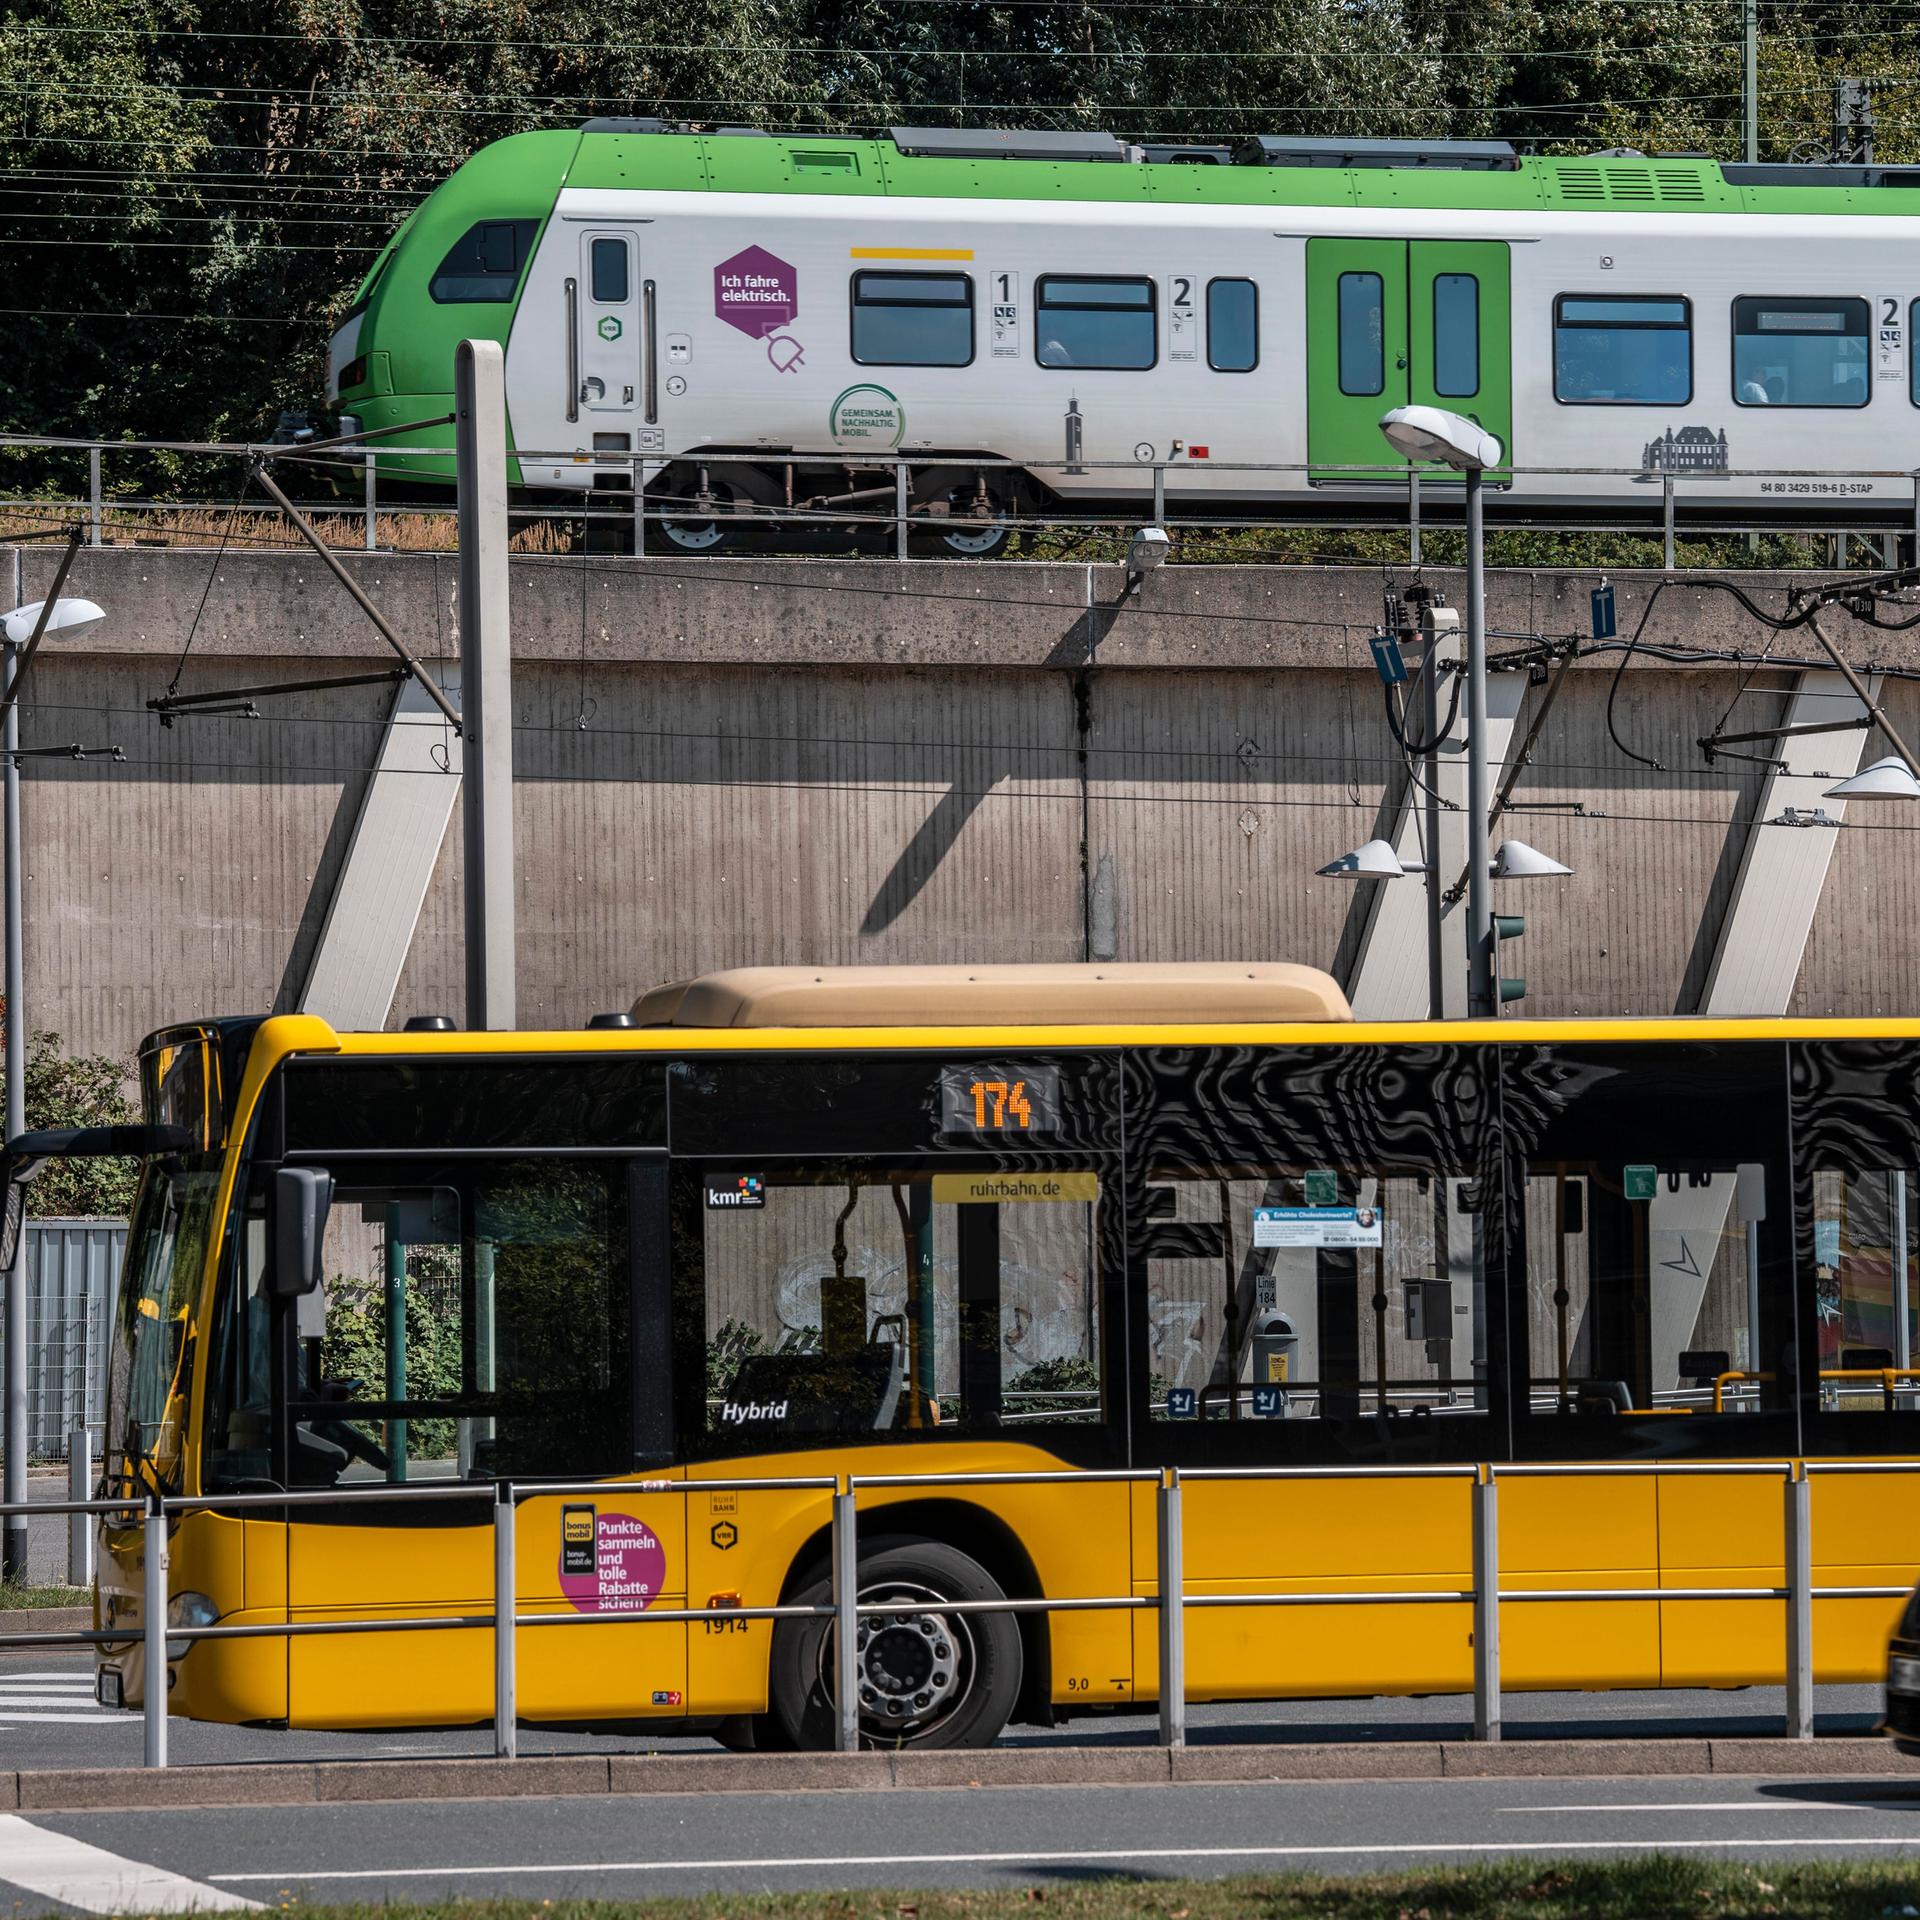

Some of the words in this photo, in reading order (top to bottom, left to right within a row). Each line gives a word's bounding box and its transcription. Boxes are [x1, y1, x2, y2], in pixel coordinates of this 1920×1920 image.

[721, 274, 741, 287] Ich
[744, 274, 779, 288] fahre
[998, 274, 1009, 302] 1
[721, 289, 791, 302] elektrisch.
[1173, 278, 1191, 306] 2
[1881, 298, 1899, 326] 2
[841, 408, 896, 418] GEMEINSAM.
[841, 418, 896, 428] NACHHALTIG.
[841, 428, 872, 437] MOBIL.
[1760, 482, 1773, 493] 94
[1774, 482, 1786, 493] 80
[1787, 483, 1810, 493] 3429
[1811, 483, 1838, 493] 519-6
[1839, 484, 1873, 495] D-STAP
[970, 1081, 1031, 1128] 174
[969, 1181, 1060, 1197] ruhrbahn.de
[709, 1188, 742, 1205] kmr
[393, 1277, 401, 1288] 3
[1257, 1277, 1276, 1289] Linie
[1258, 1292, 1277, 1304] 184
[721, 1400, 788, 1426] Hybrid
[713, 1504, 735, 1512] BAHN
[566, 1521, 591, 1530] bonus
[598, 1520, 642, 1535] Punkte
[566, 1530, 590, 1539] mobil
[598, 1535, 656, 1550] sammeln
[566, 1558, 593, 1566] mobil.de
[598, 1550, 623, 1565] und
[598, 1566, 628, 1580] tolle
[598, 1581, 649, 1596] Rabatte
[703, 1616, 749, 1635] 1914
[1068, 1678, 1090, 1691] 9,0
